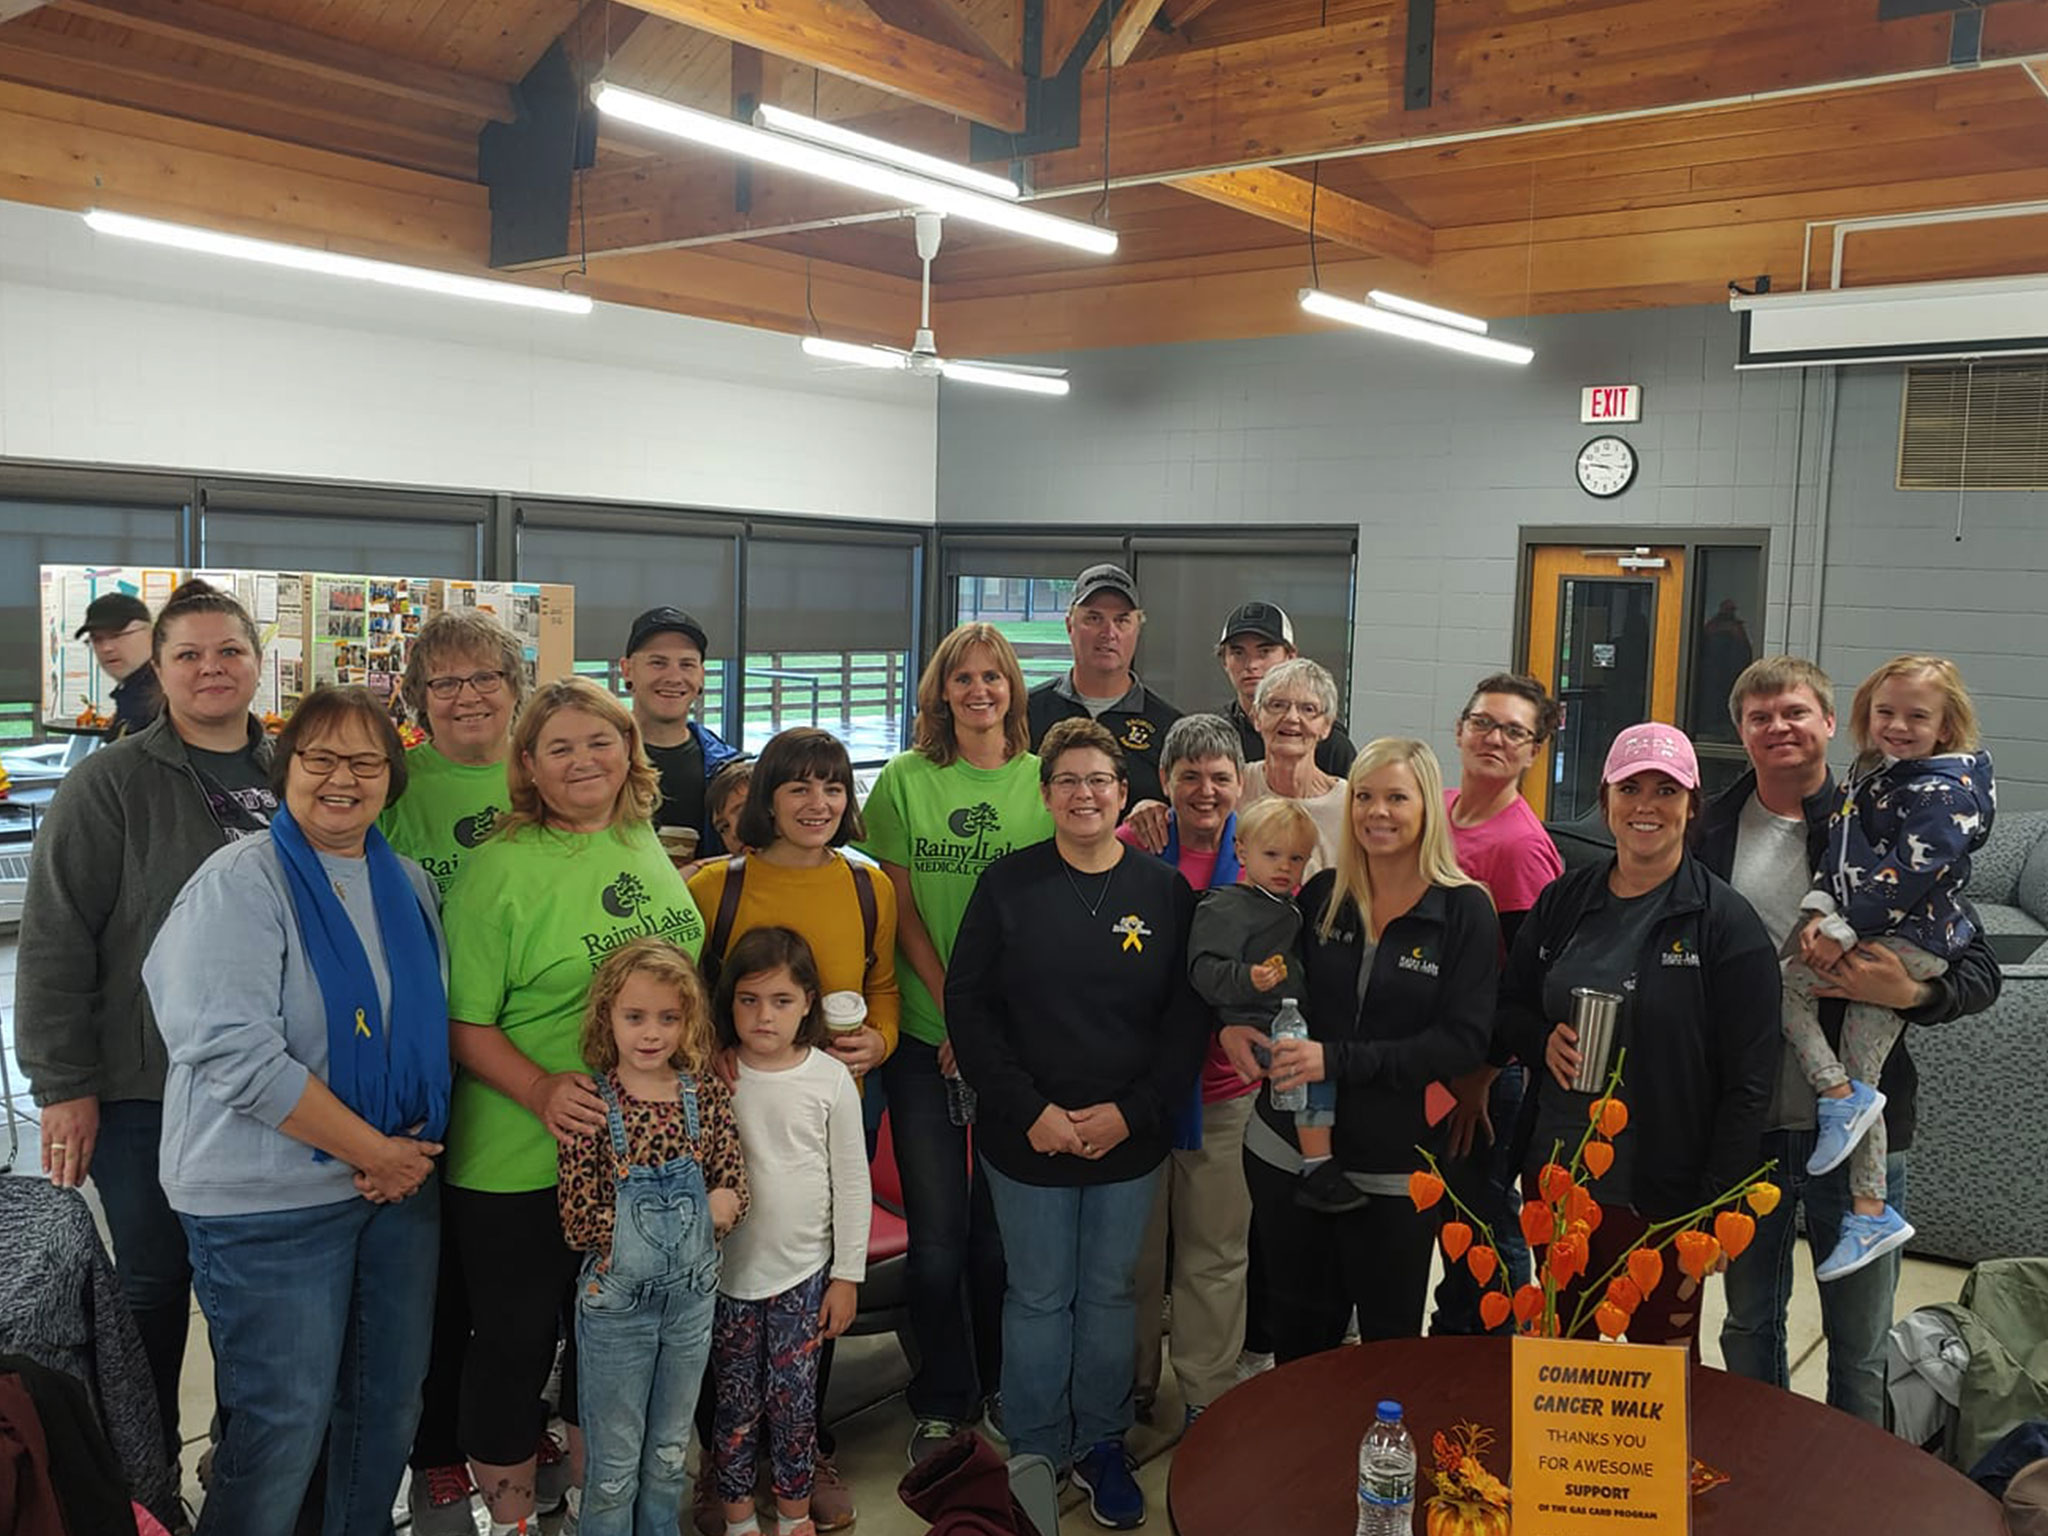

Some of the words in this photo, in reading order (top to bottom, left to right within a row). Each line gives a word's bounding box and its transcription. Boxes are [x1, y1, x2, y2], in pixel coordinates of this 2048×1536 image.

[1592, 389, 1629, 417] EXIT
[914, 837, 973, 865] Rainy
[419, 853, 459, 877] Rai
[914, 861, 972, 875] MEDICAL
[580, 925, 641, 958] Rainy
[645, 907, 696, 935] Lake
[1539, 1365, 1652, 1389] COMMUNITY
[1534, 1394, 1604, 1416] CANCER
[1611, 1399, 1664, 1420] WALK
[1547, 1428, 1610, 1446] THANKS
[1613, 1434, 1646, 1449] YOU
[1539, 1455, 1569, 1470] FOR
[1574, 1458, 1654, 1477] AWESOME
[1565, 1483, 1630, 1500] SUPPORT
[1538, 1503, 1550, 1512] OF
[1552, 1504, 1567, 1513] THE
[1570, 1505, 1586, 1515] GAS
[1589, 1506, 1611, 1517] CARD
[1614, 1508, 1658, 1520] PROGRAM
